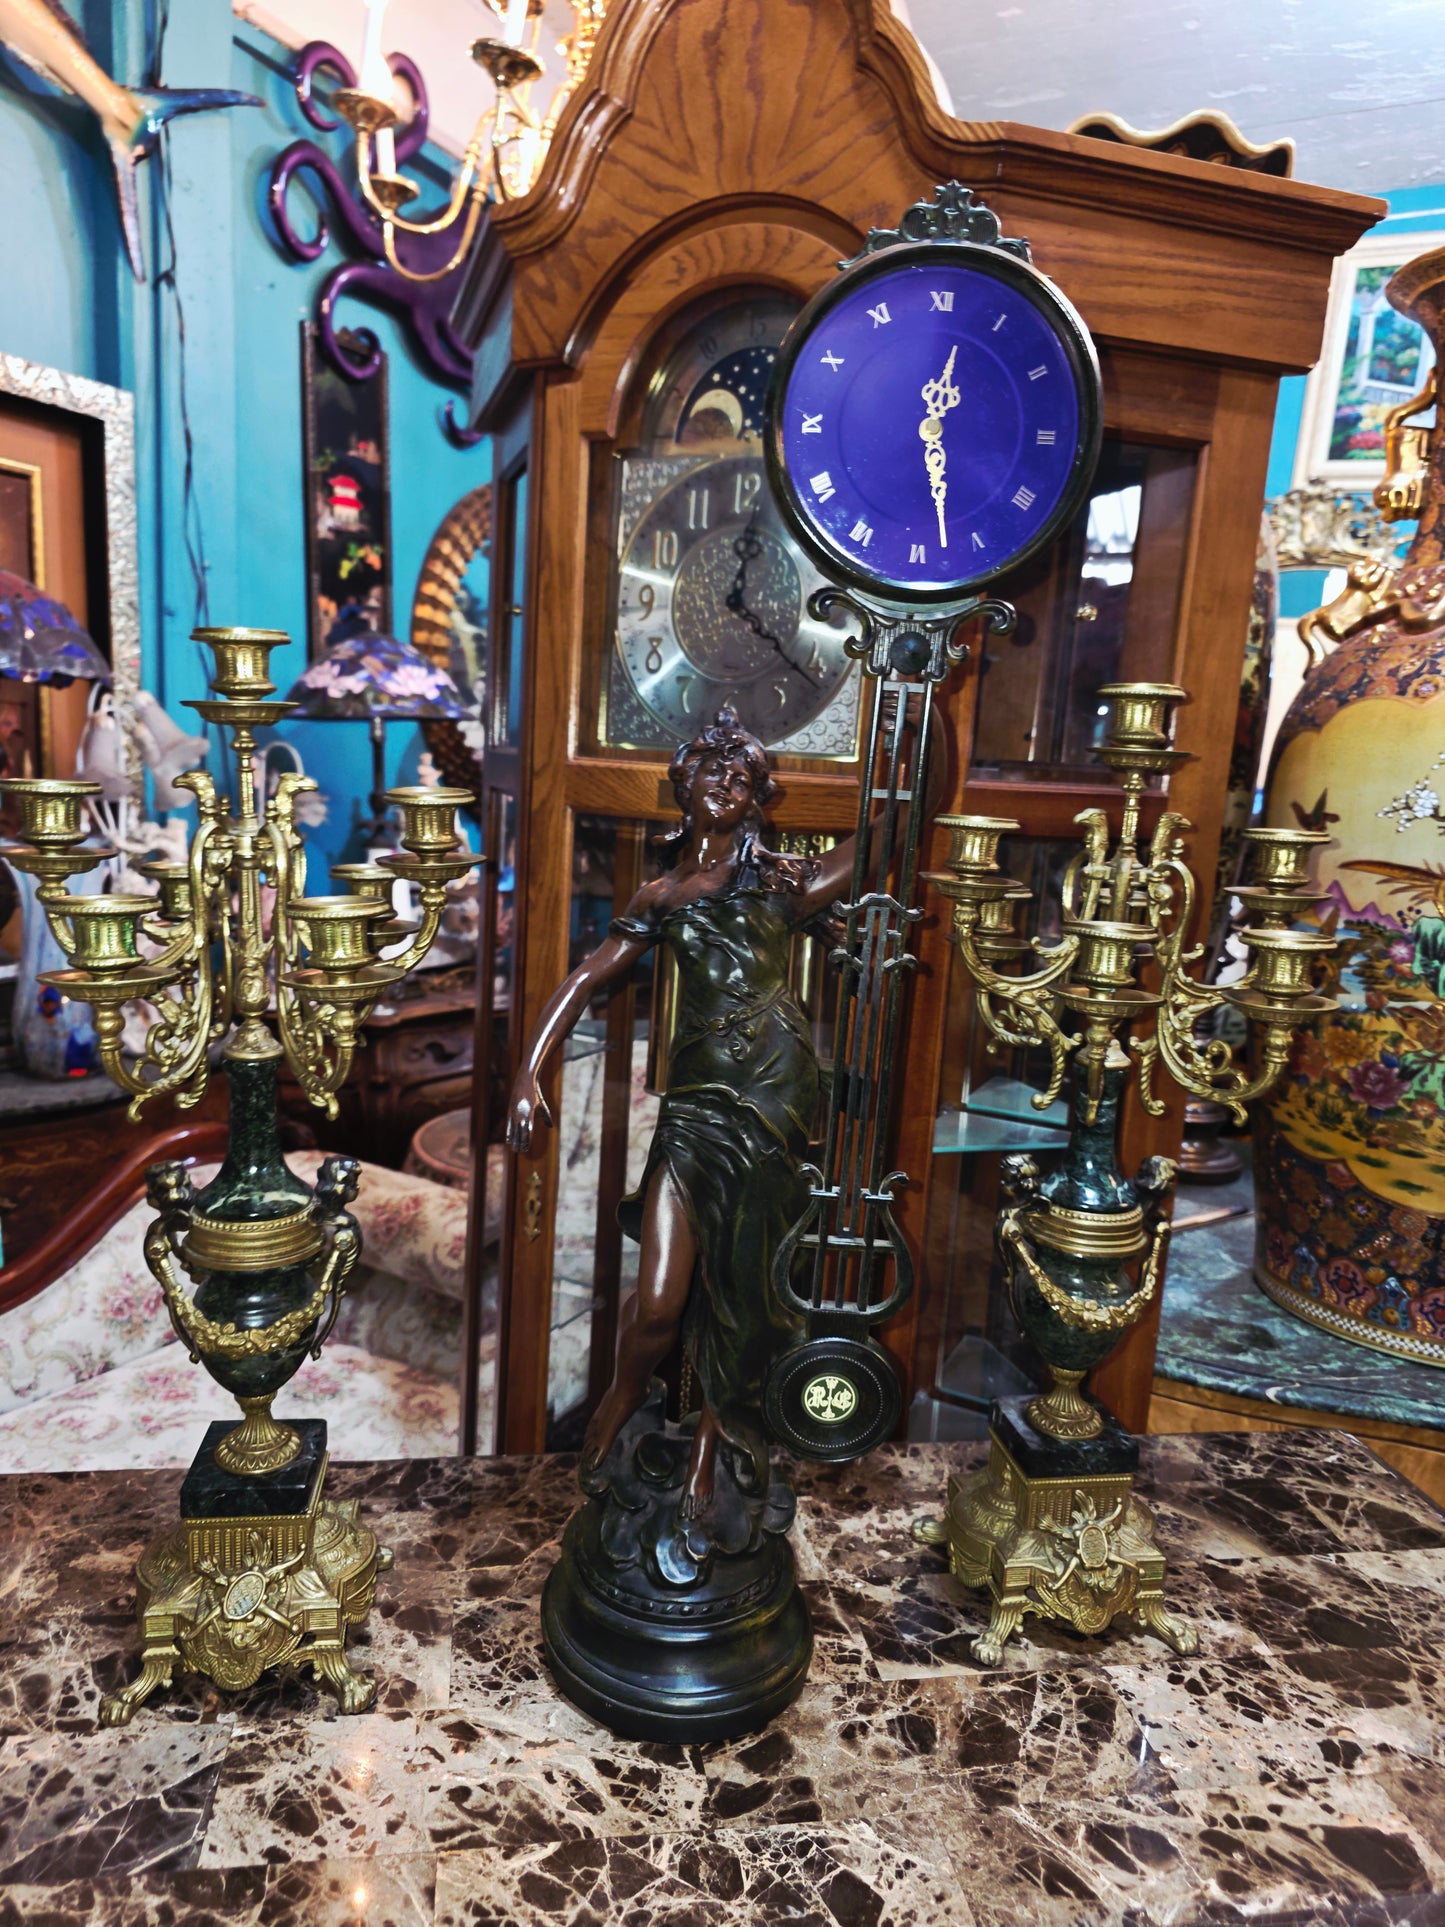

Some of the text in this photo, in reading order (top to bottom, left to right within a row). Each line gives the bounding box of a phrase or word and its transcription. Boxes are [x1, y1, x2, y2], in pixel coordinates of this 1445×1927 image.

[866, 302, 892, 328] XI
[929, 291, 955, 312] XII
[820, 349, 845, 372] X
[1027, 364, 1048, 381] II
[801, 413, 823, 434] IX
[1036, 429, 1056, 445] III
[734, 473, 760, 514] 12
[809, 471, 836, 504] VIII
[1011, 485, 1037, 511] IIII
[688, 489, 709, 530] 11
[848, 520, 874, 548] VII
[970, 532, 986, 552] V
[651, 530, 679, 570] 10
[908, 544, 926, 564] VI
[639, 584, 655, 622] 9
[645, 637, 663, 674] 8
[805, 638, 828, 680] 4
[676, 675, 697, 714] 7
